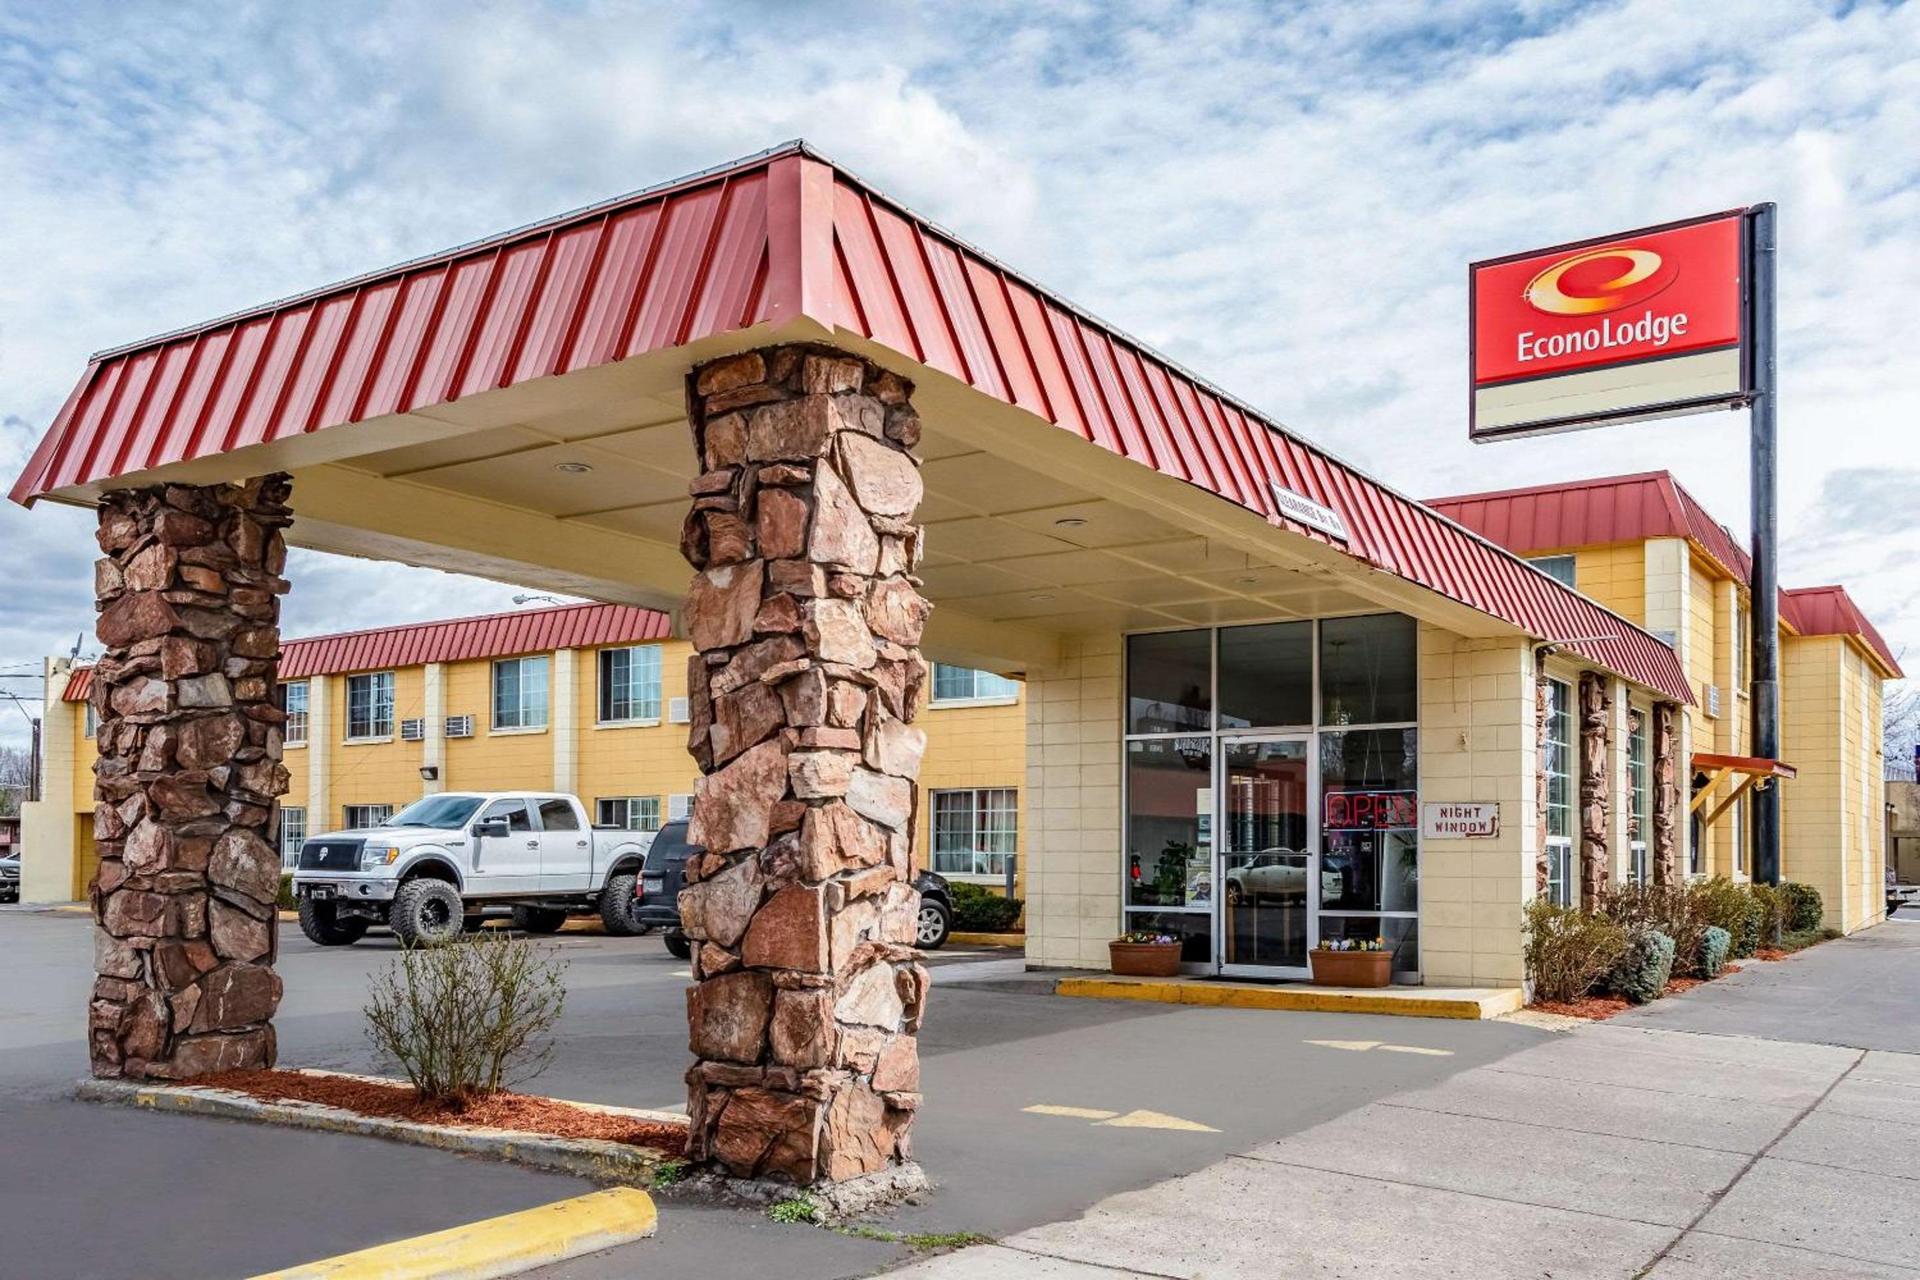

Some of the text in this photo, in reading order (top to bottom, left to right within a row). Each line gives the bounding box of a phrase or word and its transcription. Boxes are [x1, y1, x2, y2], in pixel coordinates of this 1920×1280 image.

[1517, 311, 1688, 362] EconoLodge
[1328, 794, 1417, 829] OPEN
[1440, 807, 1482, 819] NIGHT
[1435, 822, 1487, 833] WINDOW
